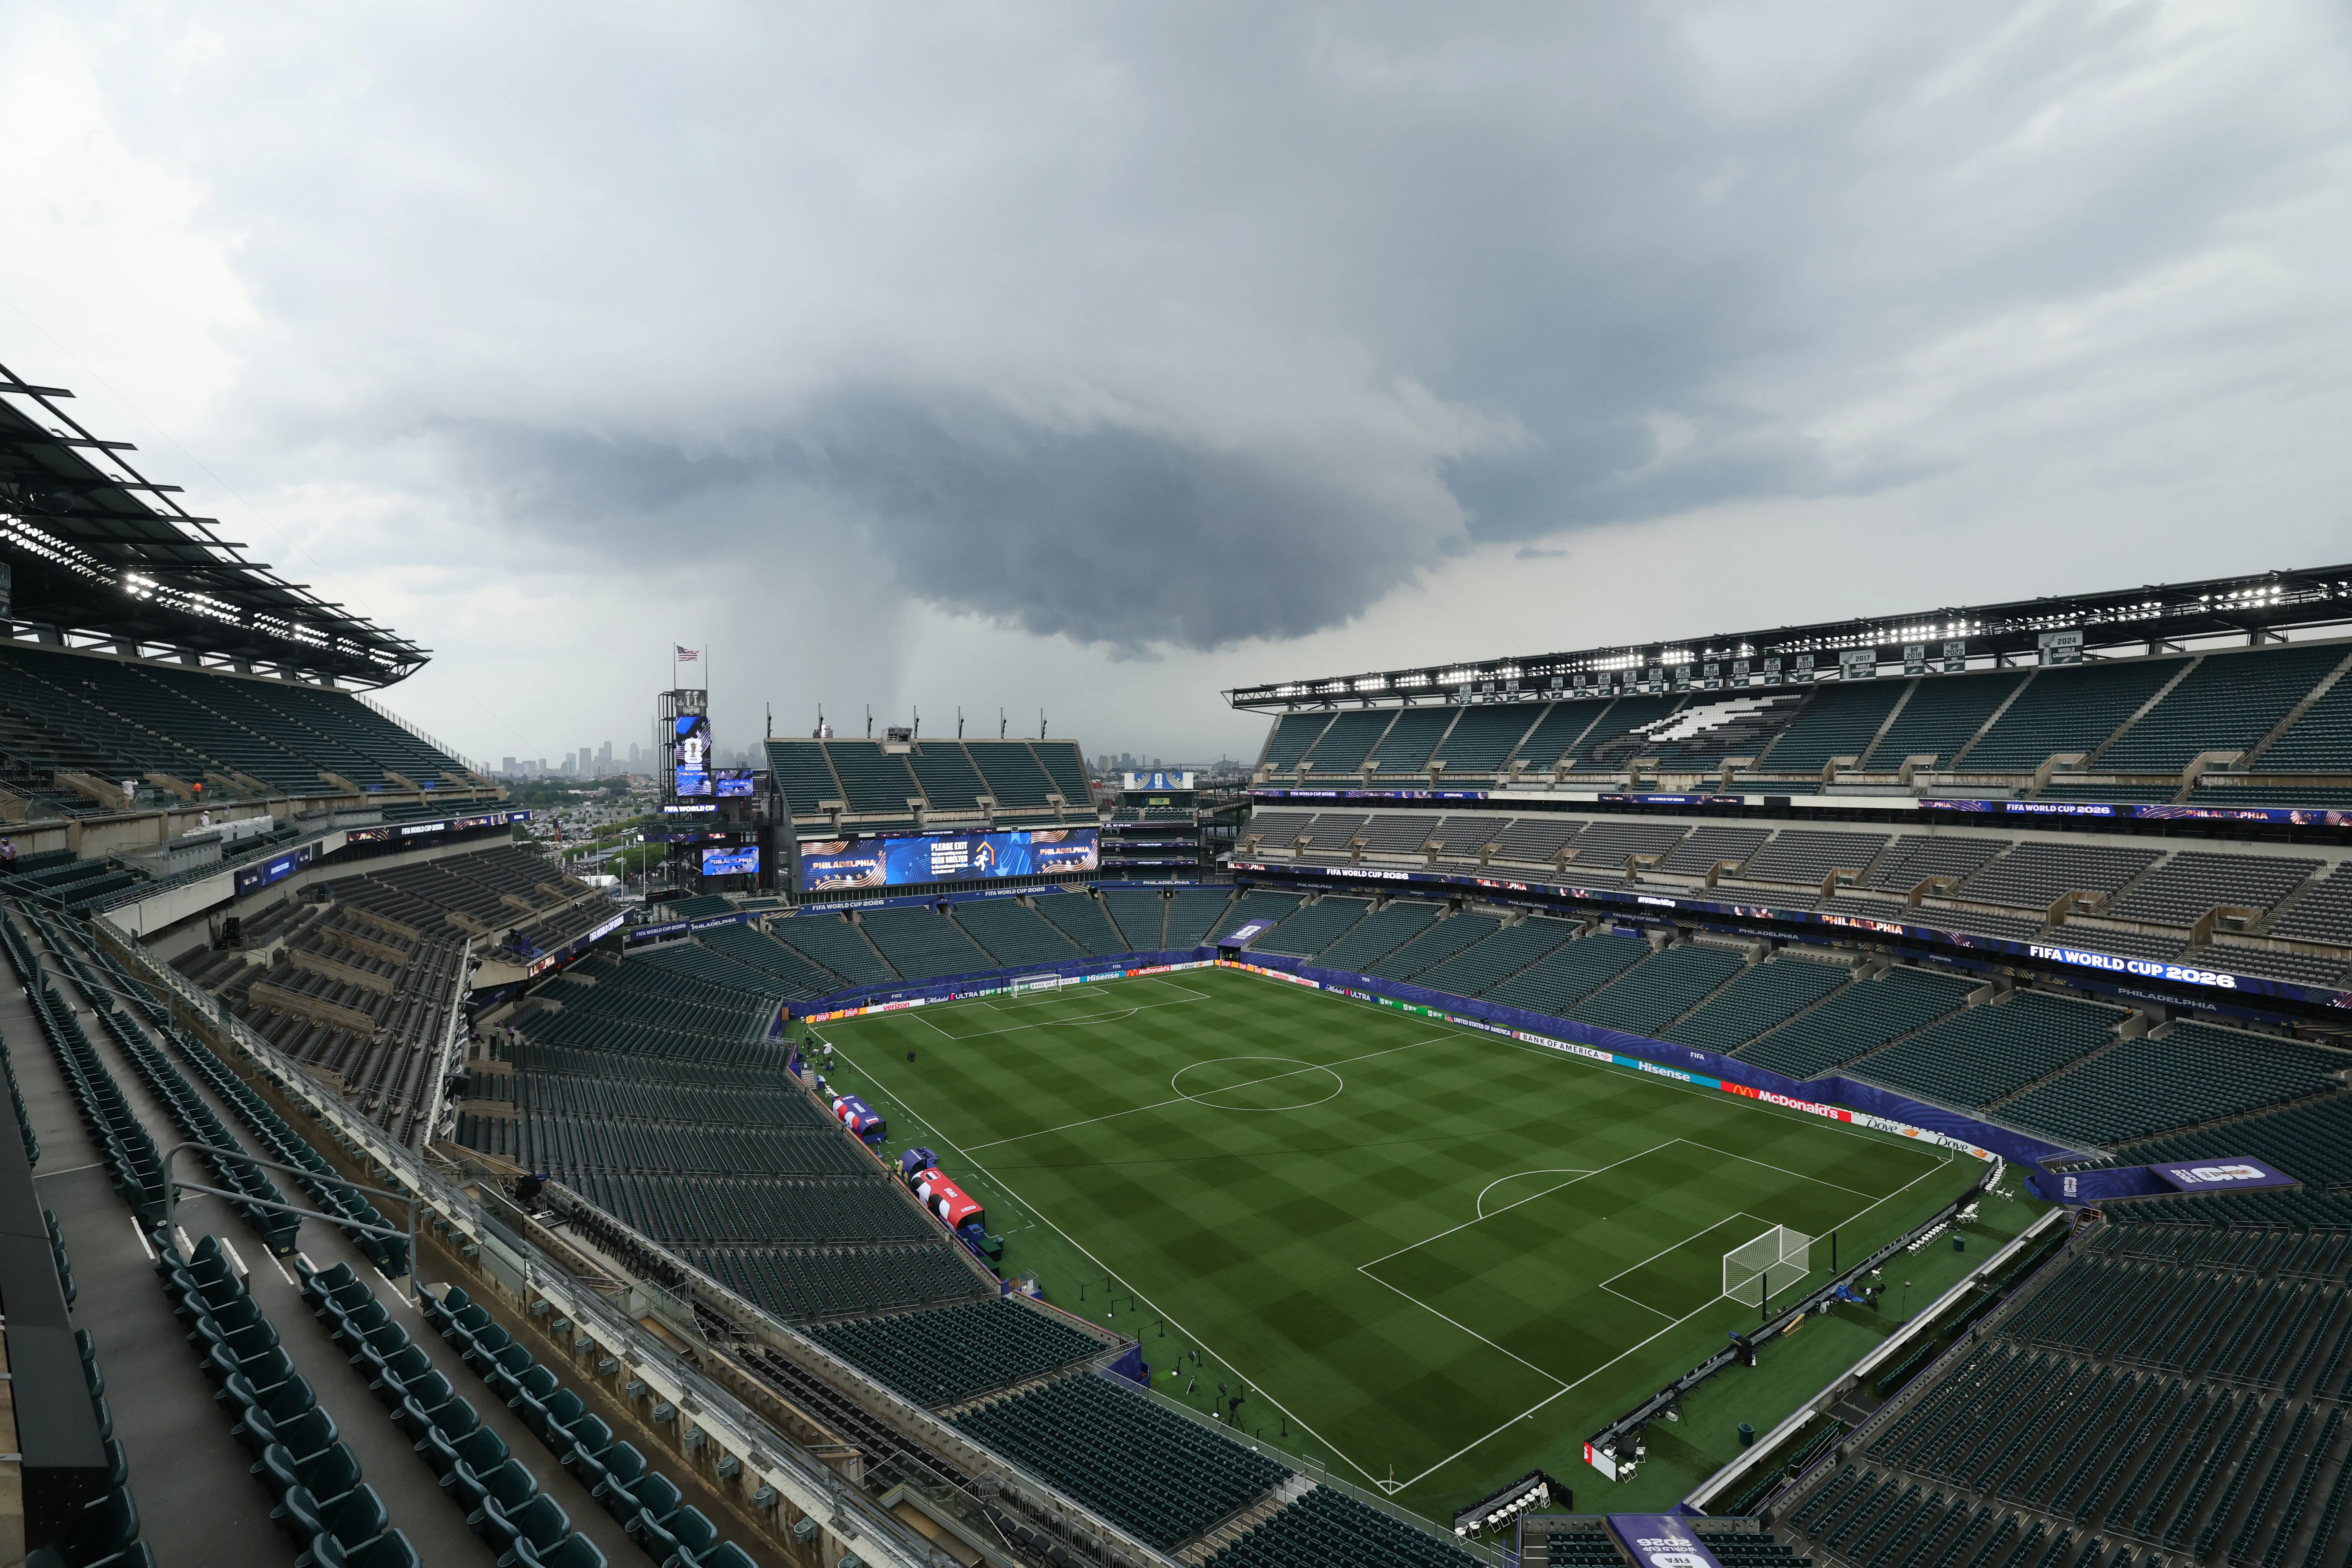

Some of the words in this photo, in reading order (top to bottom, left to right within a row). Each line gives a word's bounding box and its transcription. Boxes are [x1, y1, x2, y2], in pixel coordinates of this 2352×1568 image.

[2025, 804, 2056, 813] WORLD
[931, 842, 953, 851] PLEASE
[954, 842, 967, 850] EXIT
[1040, 846, 1089, 855] PHILADELPHIA
[813, 859, 875, 869] PHILADELPHIA
[945, 855, 968, 863] SHELTER
[1383, 872, 1409, 880] 2026
[1508, 900, 1548, 909] PHILADELPHIA
[1638, 896, 1675, 907] #FIFAWorldCup
[595, 926, 608, 939] WORLD
[613, 916, 624, 929] 2026
[691, 918, 737, 930] PHILADELPHIA
[1739, 928, 1799, 940] PHILADELPHIA
[1138, 965, 1170, 975] McDonald's
[2030, 946, 2063, 961] FIFA
[2064, 951, 2125, 970] WORLD
[2127, 960, 2163, 976] CUP
[2166, 967, 2235, 988] 2026
[1087, 972, 1119, 982] Hisense
[1296, 978, 1313, 987] verizon
[925, 996, 949, 1004] Michelob
[955, 991, 978, 999] ULTRA
[1325, 984, 1345, 995] Michelob
[1350, 991, 1371, 1002] ULTRA
[2118, 987, 2217, 1011] PHILADELPHIA
[883, 1002, 909, 1011] verizon
[816, 1013, 830, 1022] Lay's
[845, 1009, 859, 1017] Lay's
[1454, 1017, 1468, 1026] UNITED
[1468, 1021, 1484, 1029] STATES
[1490, 1026, 1511, 1036] AMERICA
[1523, 1034, 1544, 1046] BANK
[1559, 1044, 1599, 1058] AMERICA
[1690, 1051, 1705, 1060] FIFA
[1639, 1061, 1691, 1082] Hisense
[852, 1102, 866, 1113] FRANCE
[1758, 1090, 1838, 1120] McDonald's
[1866, 1118, 1898, 1134] Dove
[1936, 1135, 1968, 1153] Dove
[2170, 1169, 2197, 1183] 2026
[2180, 1169, 2193, 1178] WORLD
[944, 1187, 958, 1198] IRAQ
[1636, 1538, 1692, 1547] 2026
